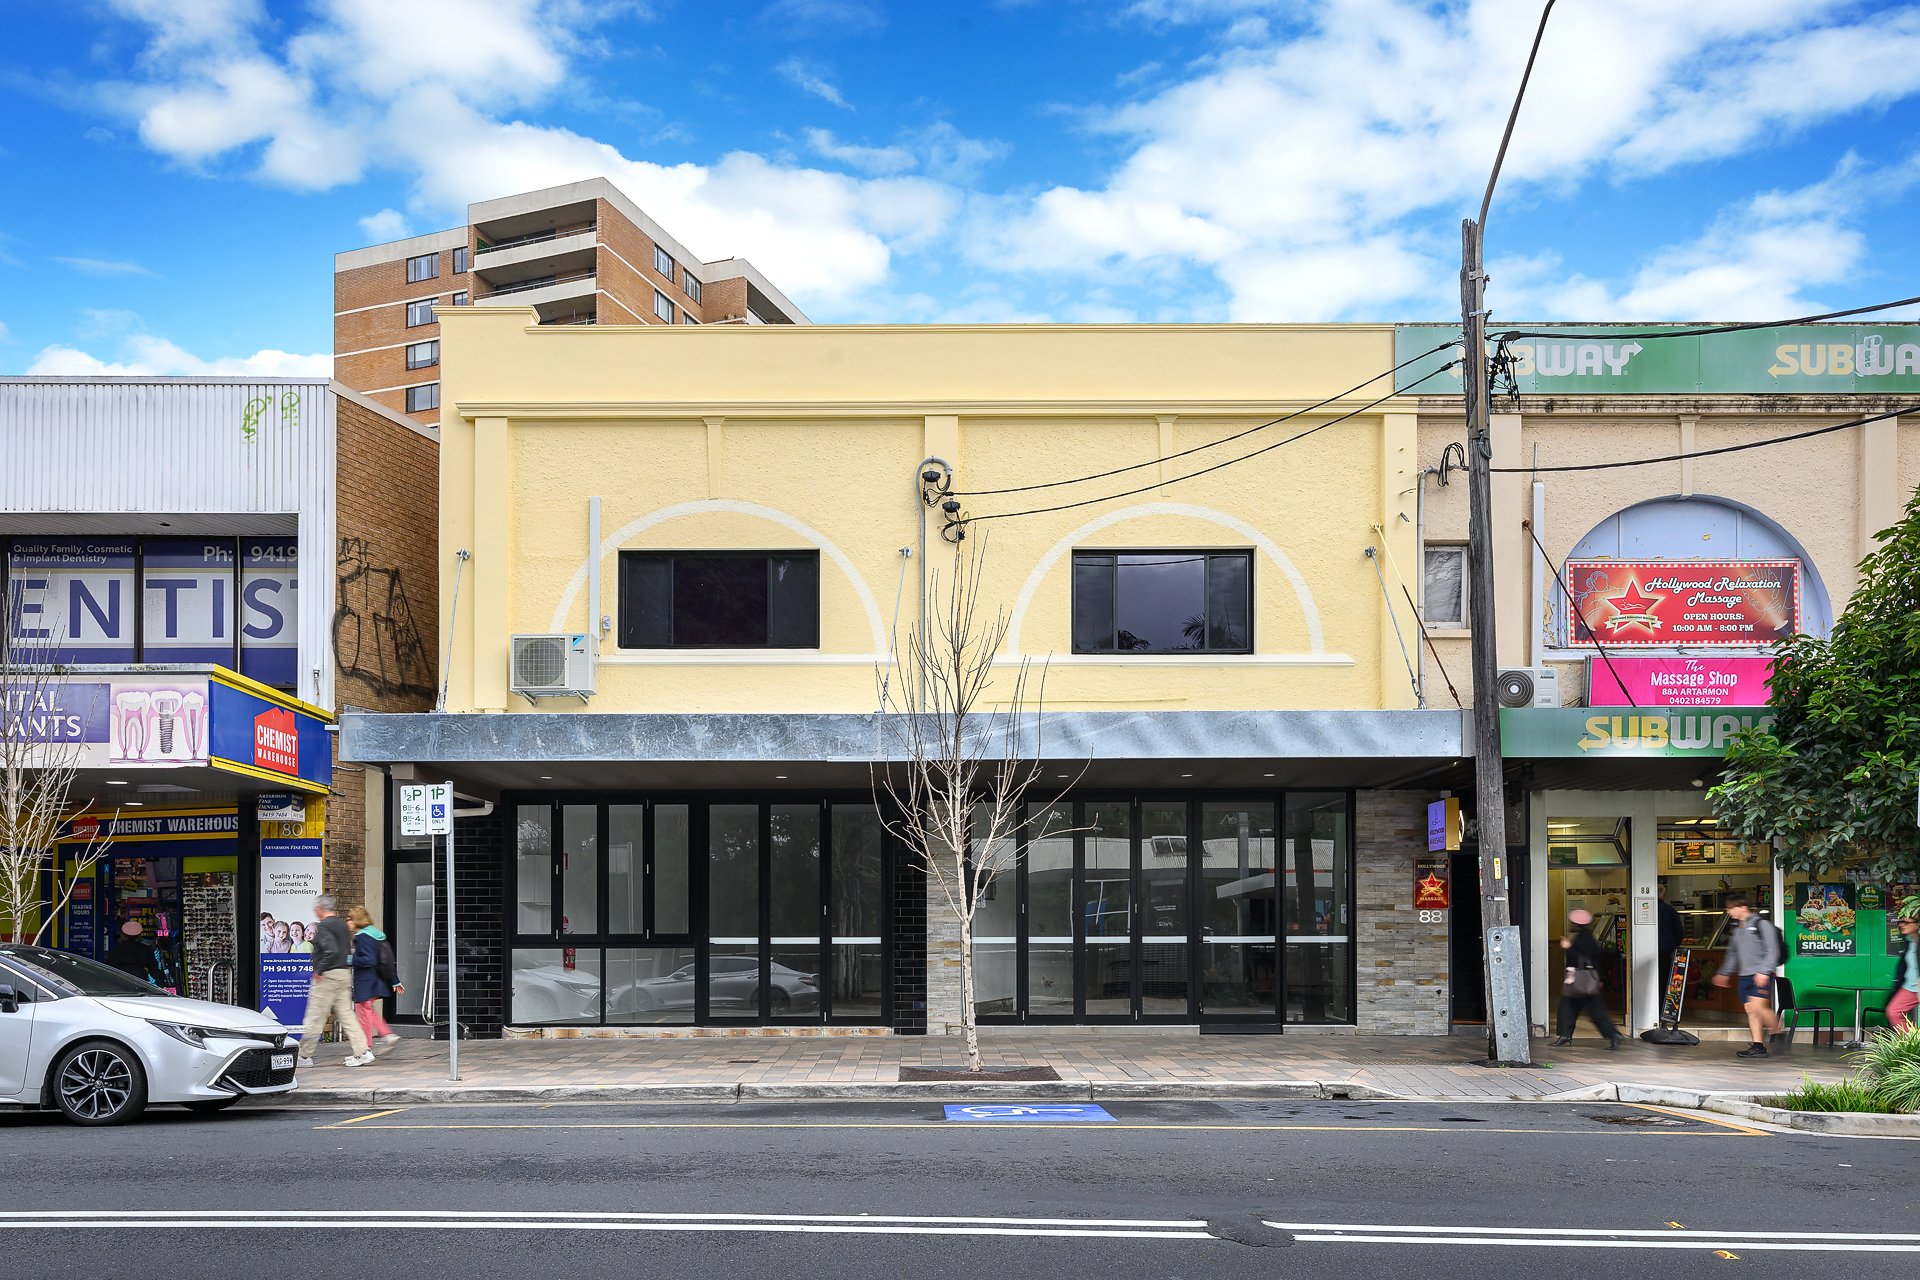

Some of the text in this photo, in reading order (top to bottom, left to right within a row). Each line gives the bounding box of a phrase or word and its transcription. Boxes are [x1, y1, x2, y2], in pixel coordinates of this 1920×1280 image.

[1449, 341, 1644, 377] BWAY
[13, 544, 133, 556] Quality Family, Cosmetic
[203, 545, 233, 562] Ph:
[250, 545, 298, 562] 9419
[13, 554, 107, 565] & Implant Dentistry
[1644, 576, 1782, 594] Hollywood Relaxation
[1686, 591, 1743, 609] Massage
[10, 577, 298, 639] ENTIS
[1683, 613, 1745, 621] OPEN HOURS:
[1672, 624, 1695, 632] 10:00
[1696, 624, 1713, 632] AM
[1719, 624, 1738, 632] 8:00
[1738, 624, 1754, 632] PM
[1685, 659, 1705, 672] The
[1650, 671, 1738, 686] Massage Shop
[1661, 688, 1729, 696] 88A ARTARMON
[257, 724, 296, 755] CHEMIST
[257, 747, 296, 768] WAREHOUSE
[430, 788, 445, 800] 1P
[108, 819, 163, 834] CHEMIST
[282, 823, 303, 837] 80
[269, 873, 291, 881] Quality
[1419, 910, 1442, 923] 88
[1799, 933, 1828, 942] feeling
[1801, 939, 1853, 953] snacky?
